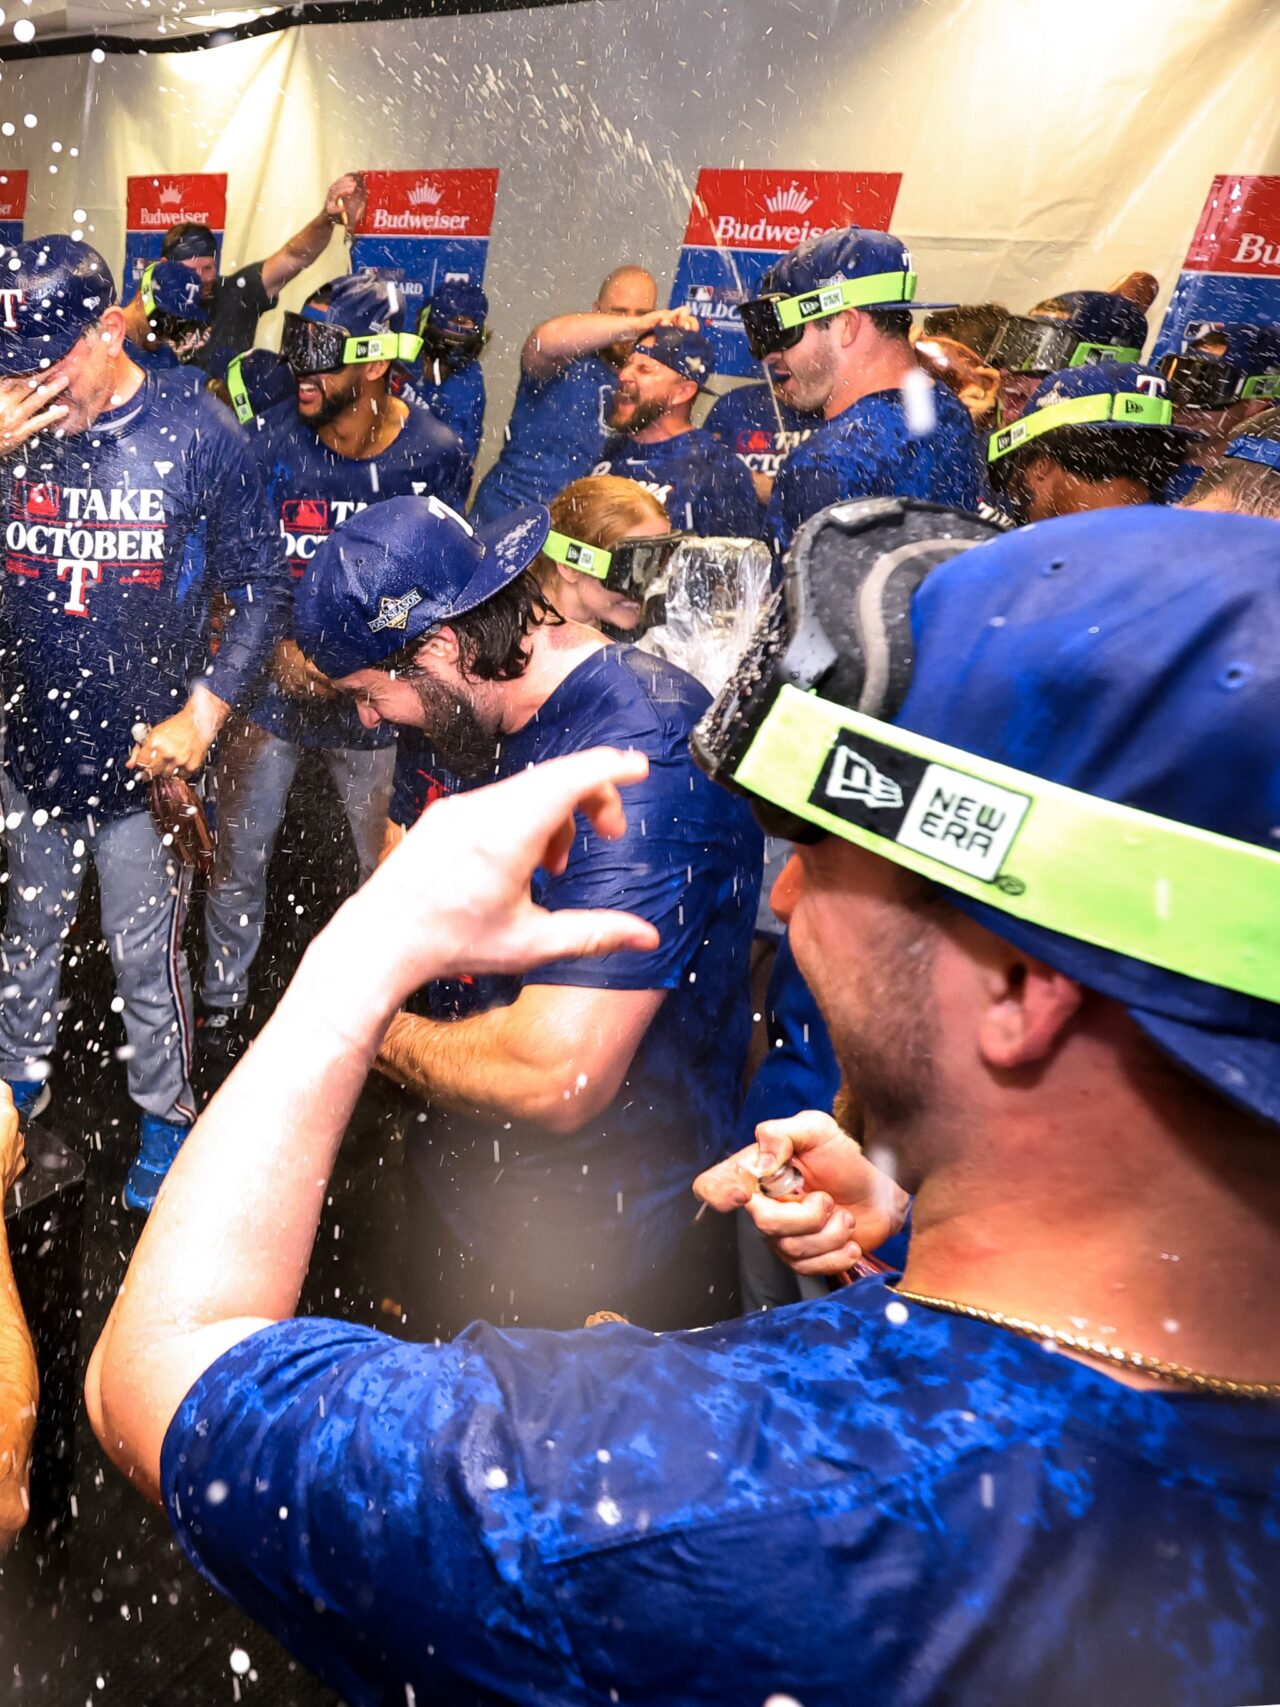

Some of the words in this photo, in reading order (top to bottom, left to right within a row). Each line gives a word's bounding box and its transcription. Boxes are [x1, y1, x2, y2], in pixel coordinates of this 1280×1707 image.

[140, 208, 209, 224] Budweiser
[373, 208, 470, 229] Budweiser
[716, 216, 825, 244] Budweis
[185, 283, 199, 304] T
[1136, 374, 1168, 398] T
[63, 488, 165, 521] TAKE
[6, 521, 165, 560] OCTOBER
[56, 558, 104, 618] T
[929, 787, 1007, 832] NEW
[919, 811, 993, 858] ERA
